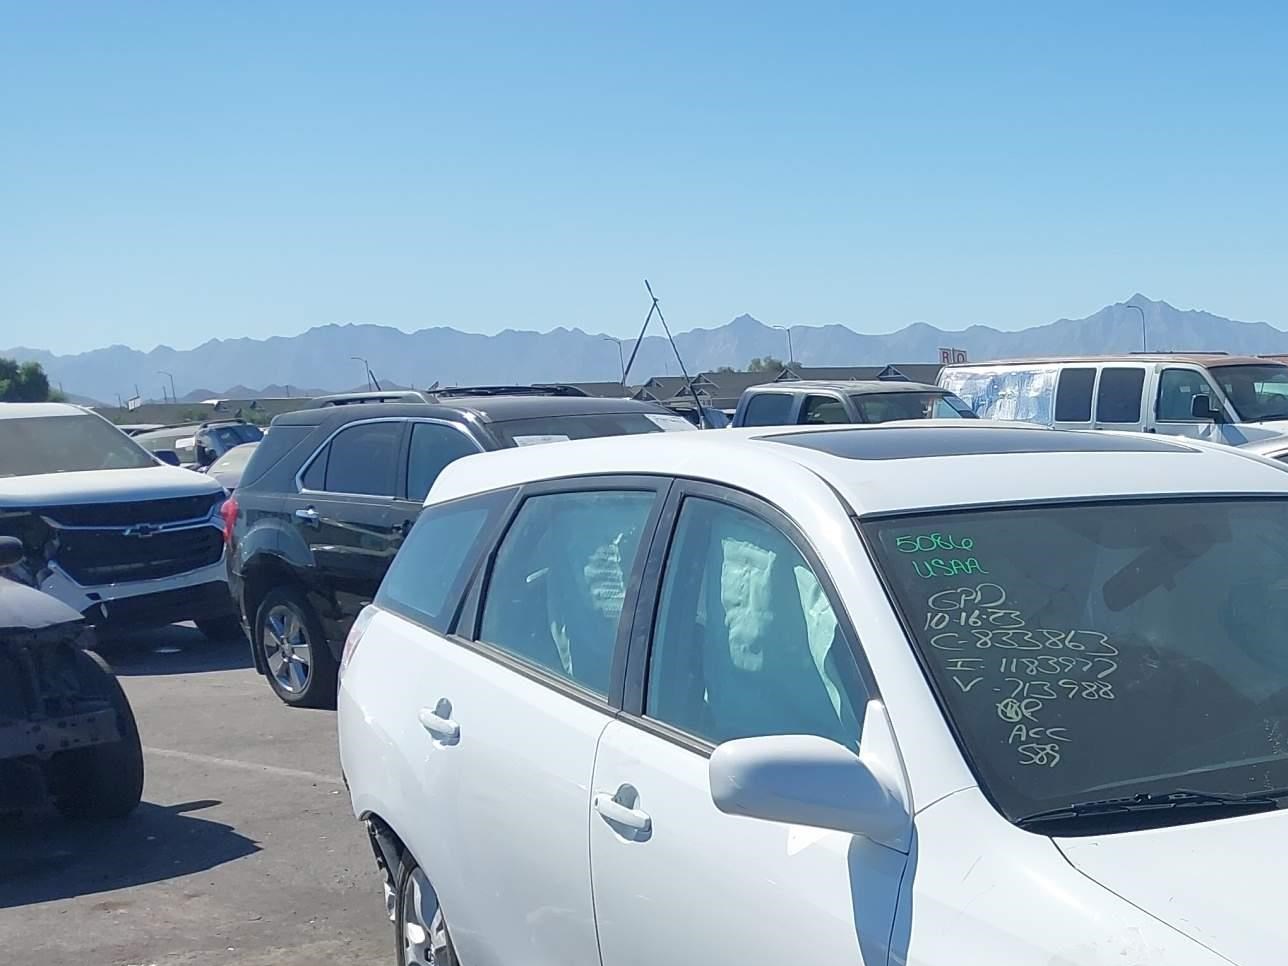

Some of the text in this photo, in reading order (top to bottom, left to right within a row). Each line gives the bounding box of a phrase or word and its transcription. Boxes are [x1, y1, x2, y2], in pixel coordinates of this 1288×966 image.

[896, 534, 974, 553] 5086
[912, 558, 989, 578] USAA
[928, 583, 1006, 610] GPD
